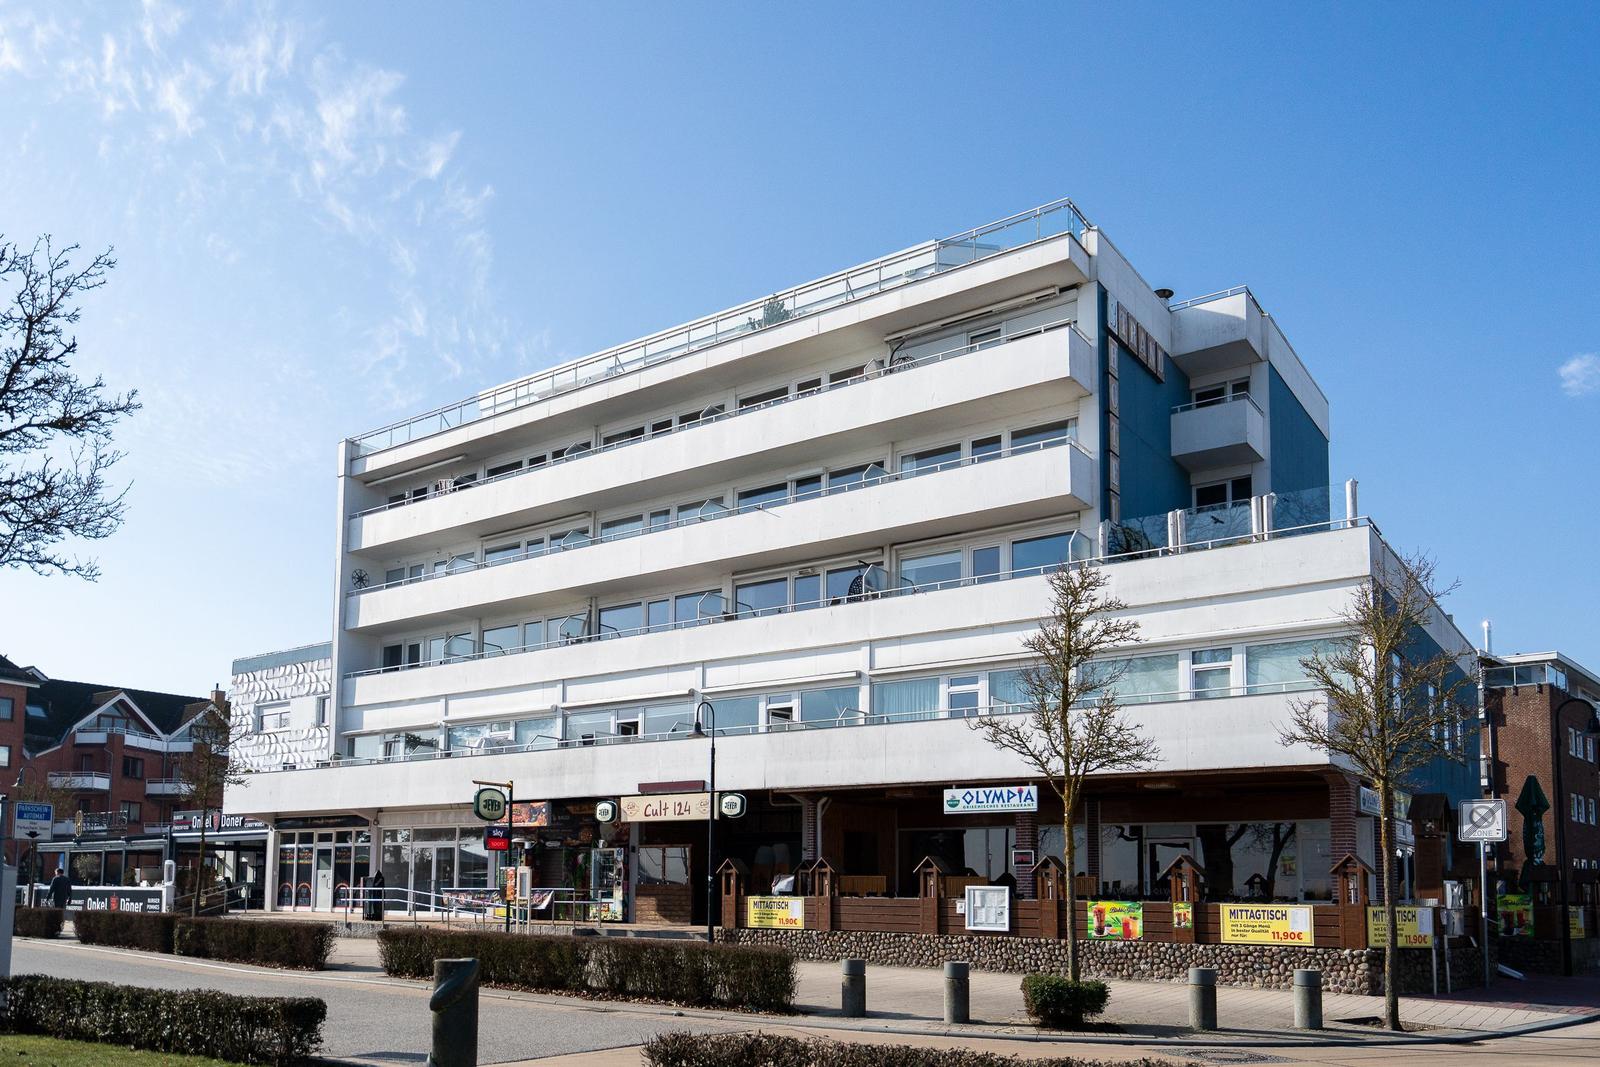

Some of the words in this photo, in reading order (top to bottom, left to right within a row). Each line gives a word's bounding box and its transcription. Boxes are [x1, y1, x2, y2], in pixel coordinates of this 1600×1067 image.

[962, 788, 1034, 804] OLYMPIA
[482, 798, 501, 812] JEVER
[644, 800, 669, 817] Cult
[673, 801, 691, 816] 124
[724, 801, 737, 809] JEVER
[221, 815, 244, 828] Döner
[492, 829, 505, 837] sky
[87, 898, 108, 910] Onkel
[120, 898, 143, 912] Döner
[753, 901, 789, 909] MITTAGTISCH
[1229, 909, 1287, 920] MITTAGTISCH
[1372, 910, 1416, 922] MITTISCH
[778, 917, 798, 925] 11,90€
[1271, 931, 1303, 941] 11,90€
[1404, 935, 1428, 945] 11,90€
